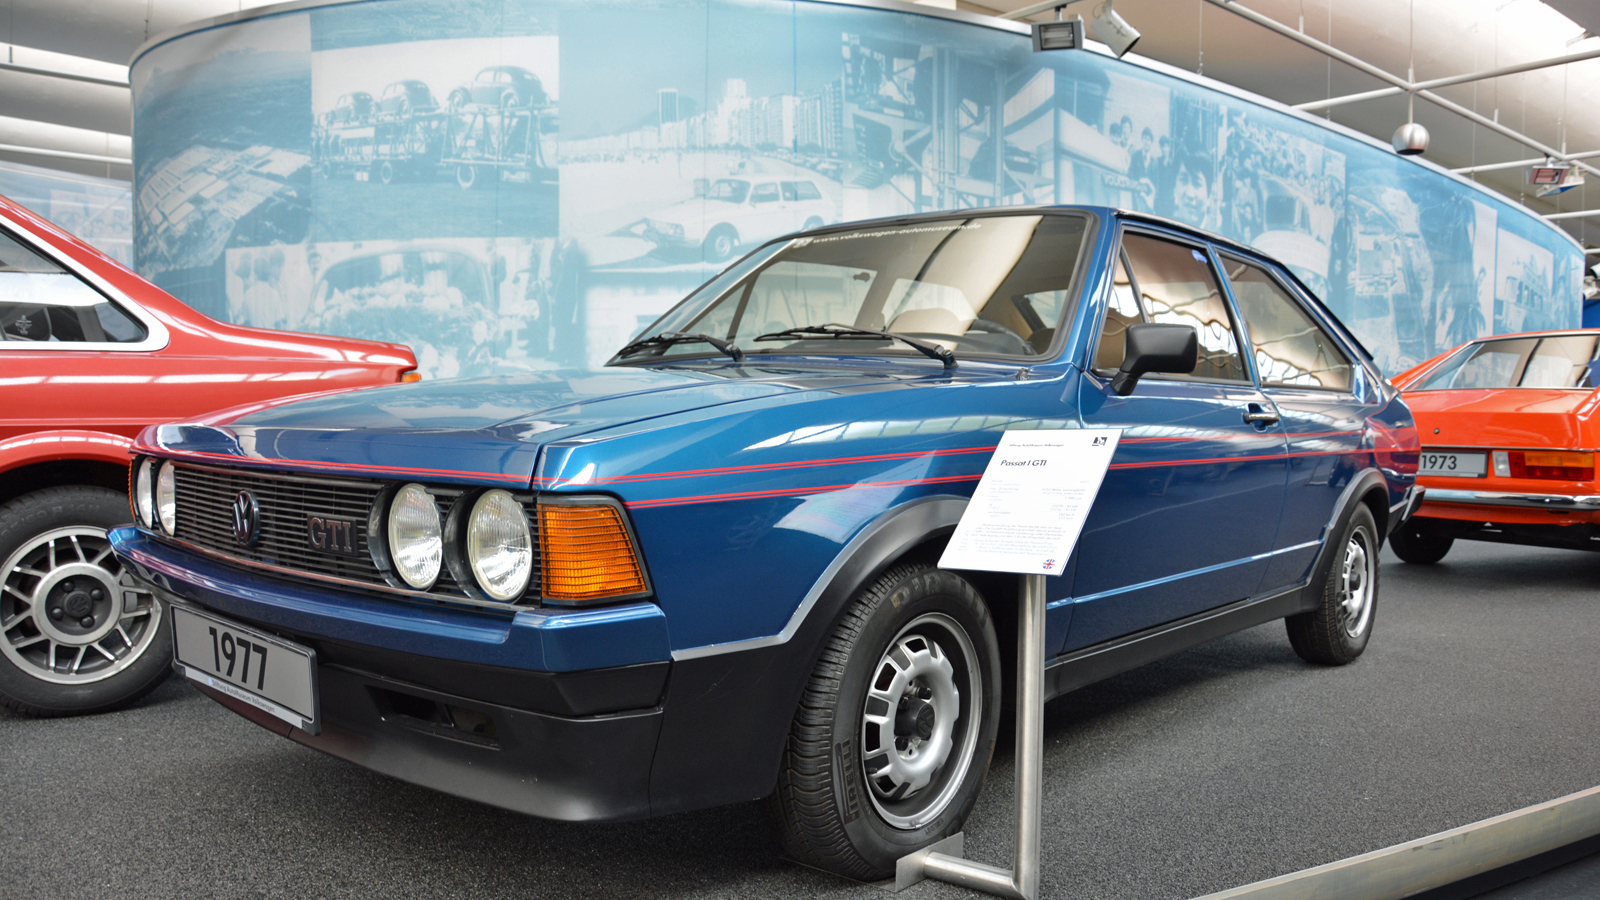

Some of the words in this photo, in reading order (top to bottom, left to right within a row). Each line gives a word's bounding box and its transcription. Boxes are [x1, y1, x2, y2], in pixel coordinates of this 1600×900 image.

[1000, 459, 1026, 467] Passat
[1032, 459, 1047, 467] GTI
[1421, 454, 1457, 470] 1973
[310, 516, 352, 551] GTI
[208, 625, 268, 691] 1977
